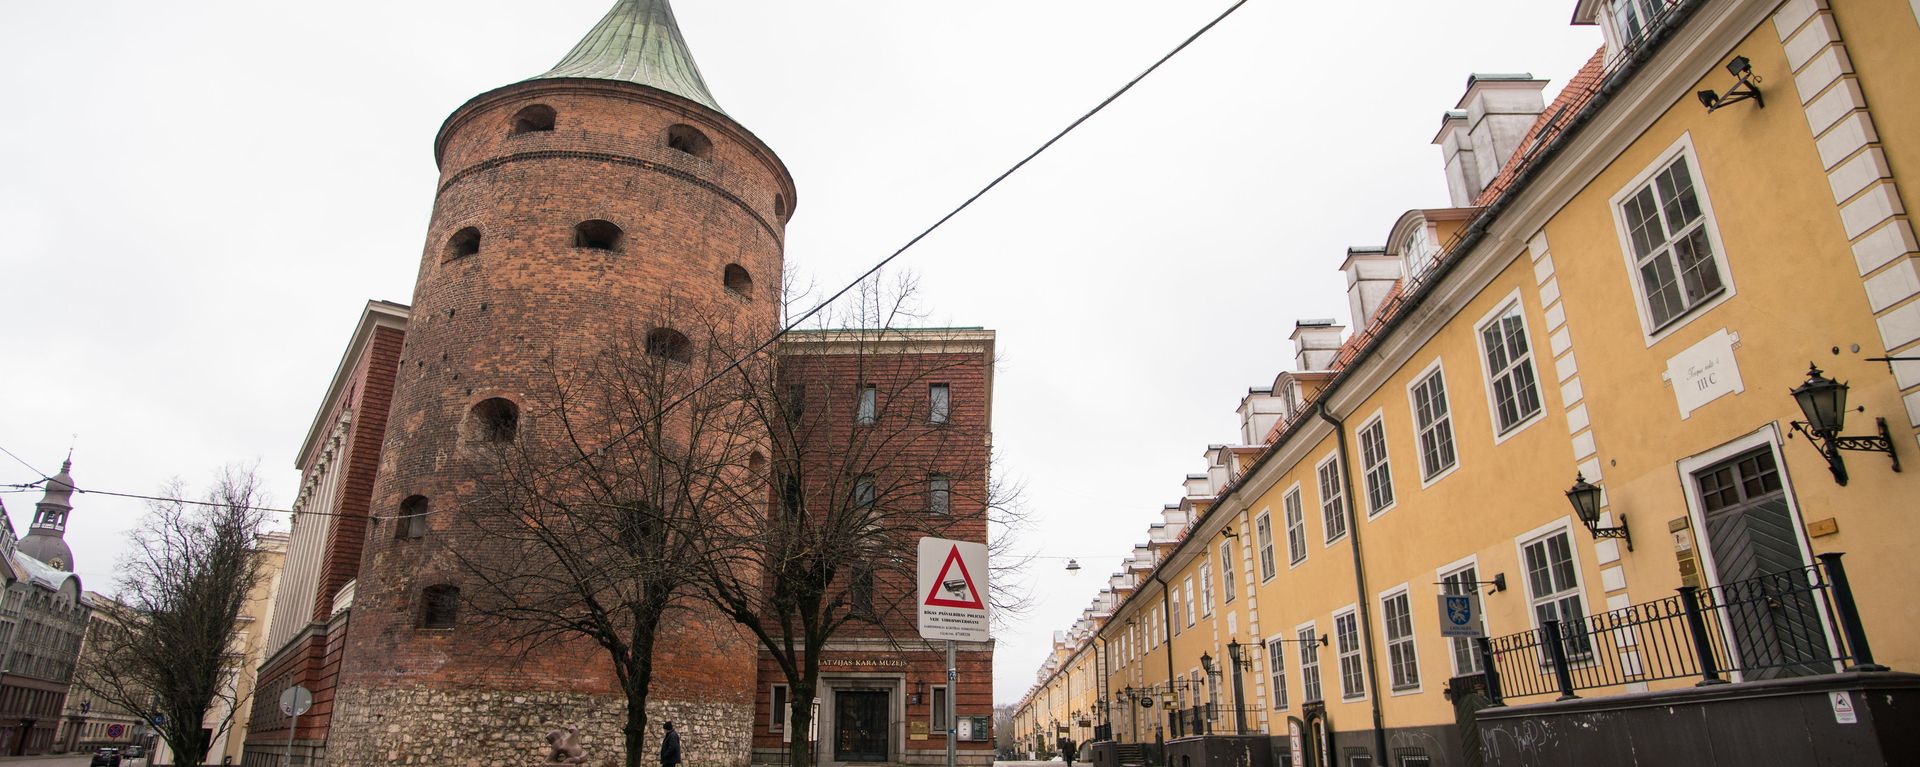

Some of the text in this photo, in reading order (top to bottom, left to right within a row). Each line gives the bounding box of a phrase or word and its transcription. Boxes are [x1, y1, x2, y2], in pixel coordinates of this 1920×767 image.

[1697, 373, 1717, 391] III C
[818, 659, 853, 667] LATVIJAS
